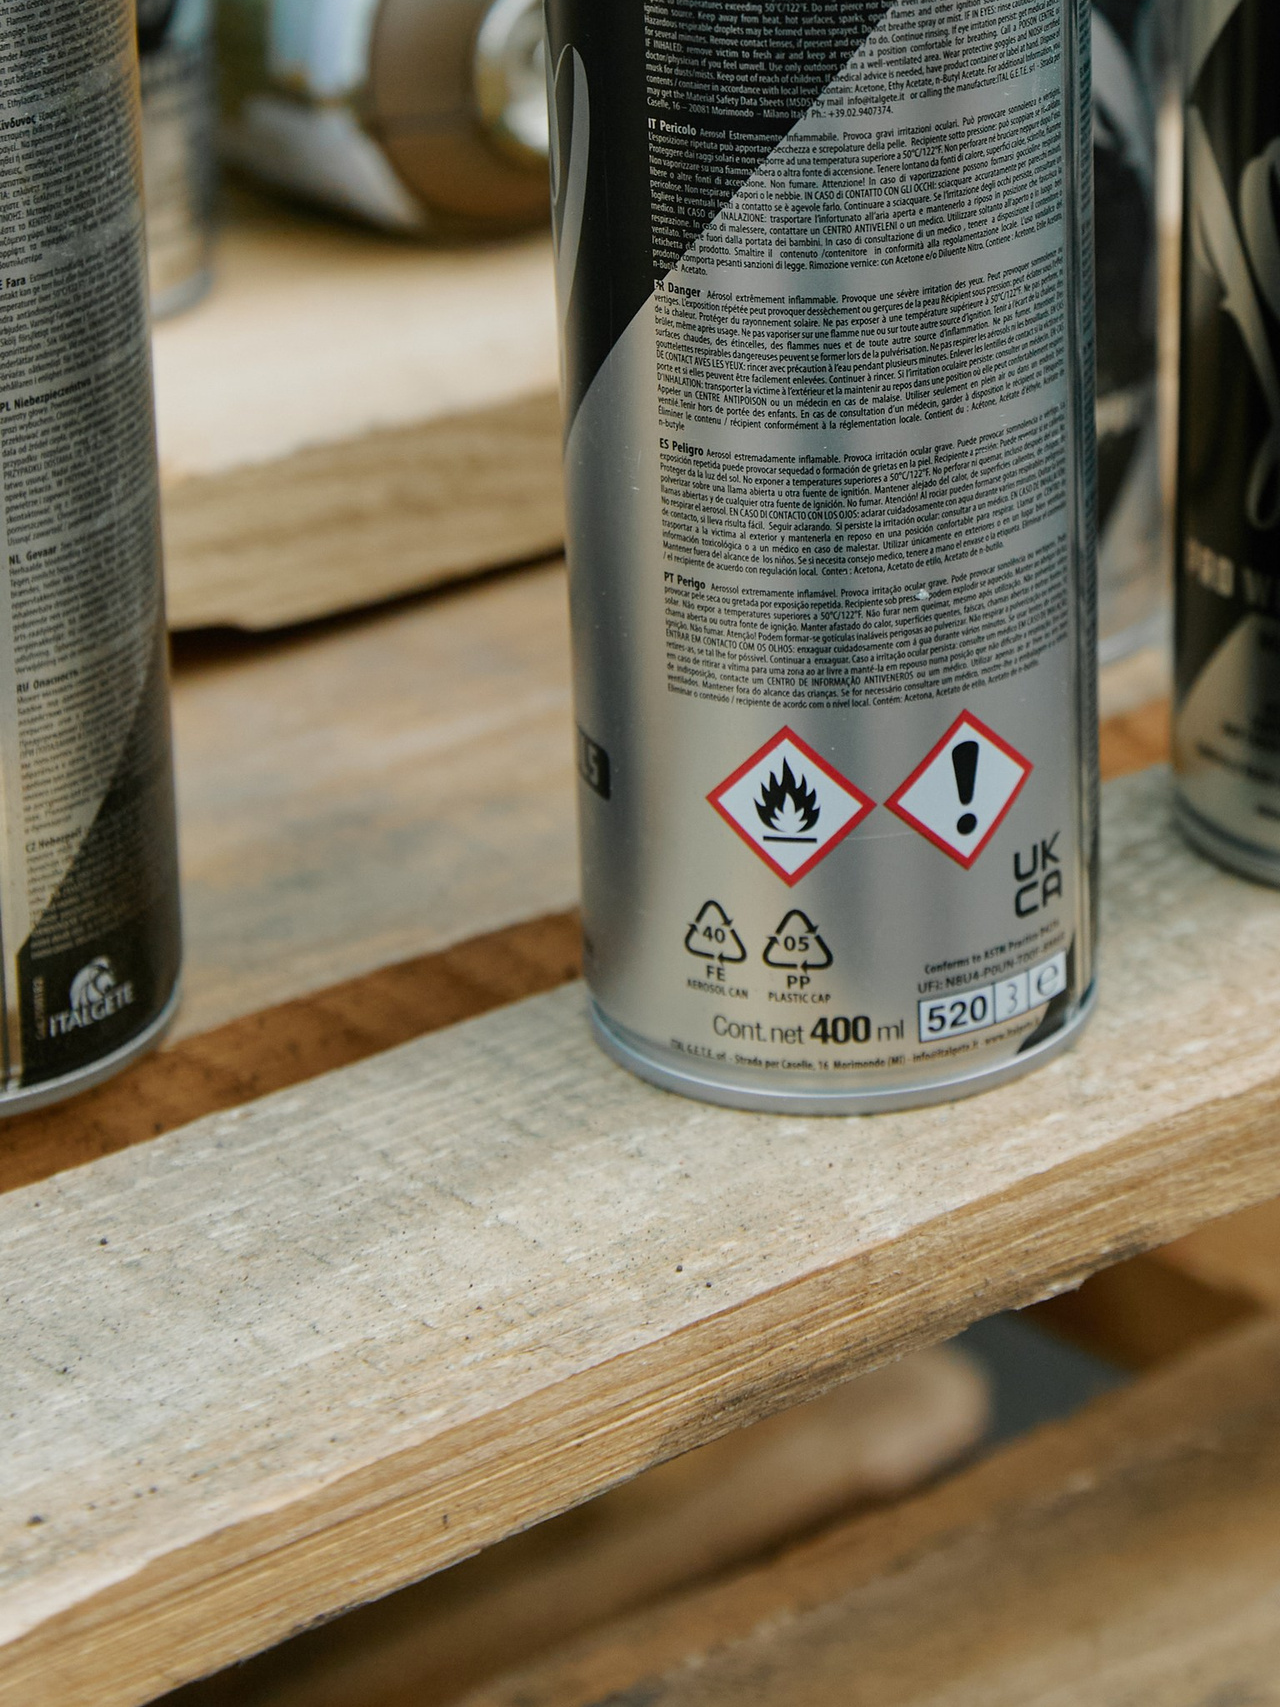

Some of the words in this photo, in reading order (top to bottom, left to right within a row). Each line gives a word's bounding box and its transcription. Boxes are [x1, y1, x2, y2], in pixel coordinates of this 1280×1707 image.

[647, 95, 670, 111] Caselle,
[672, 100, 680, 110] 16
[712, 104, 754, 117] Morimondo
[763, 108, 789, 118] Milano
[811, 108, 825, 118] Ph.:
[828, 104, 892, 117] +39.02.9407374.
[648, 116, 655, 129] IT
[660, 119, 696, 135] Pericolo
[700, 127, 725, 138] Aerosol
[843, 130, 872, 140] Provoca
[876, 127, 893, 141] gravi
[898, 122, 931, 136] irritazioni
[934, 117, 958, 130] oculari.
[962, 114, 974, 125] Può
[681, 262, 706, 275] Acetato.
[6, 276, 27, 288] Fara
[668, 280, 700, 300] Danger
[706, 289, 732, 300] Aérosol
[736, 292, 784, 303] extrêmement
[788, 294, 838, 303] inflammable.
[842, 291, 876, 305] Provoque
[880, 292, 893, 300] une
[896, 286, 918, 298] sévère
[922, 281, 952, 295] irritation
[954, 278, 966, 289] des
[968, 276, 984, 289] yeux.
[987, 269, 1000, 281] Peut
[656, 347, 663, 358] DE
[665, 350, 692, 364] CONTACT
[694, 355, 710, 367] AVES
[712, 358, 724, 368] LES
[747, 361, 767, 371] rincer
[786, 363, 826, 375] précaution
[853, 359, 883, 373] pendant
[885, 355, 917, 370] plusieurs
[918, 350, 948, 364] minutes.
[950, 344, 972, 359] Enlever
[974, 342, 982, 353] les
[658, 415, 684, 433] n-butyle
[660, 435, 668, 449] ES
[672, 439, 703, 459] Peligro
[706, 447, 731, 460] Aerosol
[734, 451, 795, 463] estremadamente
[798, 453, 840, 463] inflamable.
[844, 451, 872, 462] Provoca
[875, 447, 907, 460] irritación
[910, 444, 931, 456] ocular
[934, 442, 954, 455] grave.
[957, 434, 976, 448] Puede
[979, 429, 1003, 445] provocar
[664, 569, 673, 583] PT
[677, 572, 705, 593] Perigo
[741, 586, 794, 597] extremamente
[797, 587, 836, 597] inflamável.
[840, 585, 868, 596] Provoca
[872, 582, 901, 597] irritação
[904, 579, 925, 591] ocular
[928, 577, 948, 590] grave.
[951, 570, 966, 583] Pode
[969, 565, 994, 581] provocar
[1014, 831, 1061, 881] UK
[702, 926, 726, 944] 40
[783, 936, 810, 952] 05
[706, 965, 726, 982] FE
[787, 975, 811, 990] PP
[728, 987, 748, 999] CAN
[768, 992, 808, 1004] PLASTIC
[811, 994, 831, 1004] CAP
[49, 979, 135, 1039] ITALGETE
[927, 995, 988, 1033] 520
[810, 1015, 871, 1044] 400
[877, 1019, 904, 1042] ml
